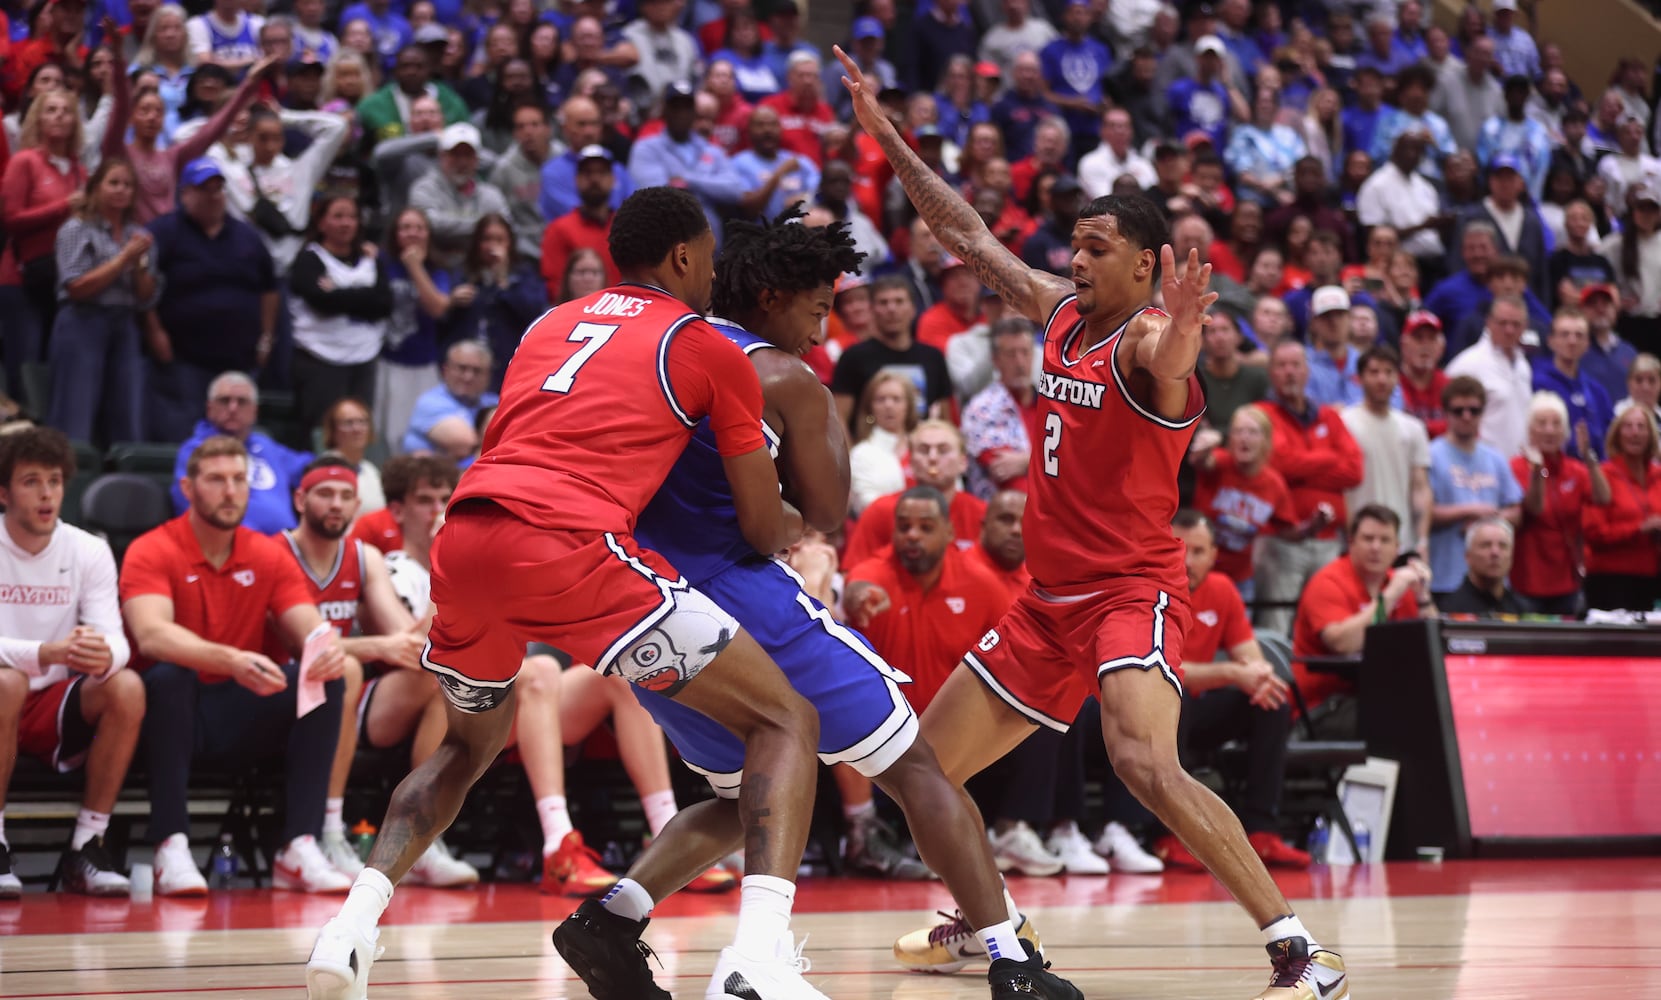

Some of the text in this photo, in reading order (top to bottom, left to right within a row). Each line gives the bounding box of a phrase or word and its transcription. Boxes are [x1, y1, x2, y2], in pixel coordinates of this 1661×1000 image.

[583, 292, 653, 317] JONES
[540, 321, 621, 395] 7
[1039, 370, 1106, 409] AYTON
[1043, 411, 1062, 477] 2
[0, 584, 71, 606] DAYTON
